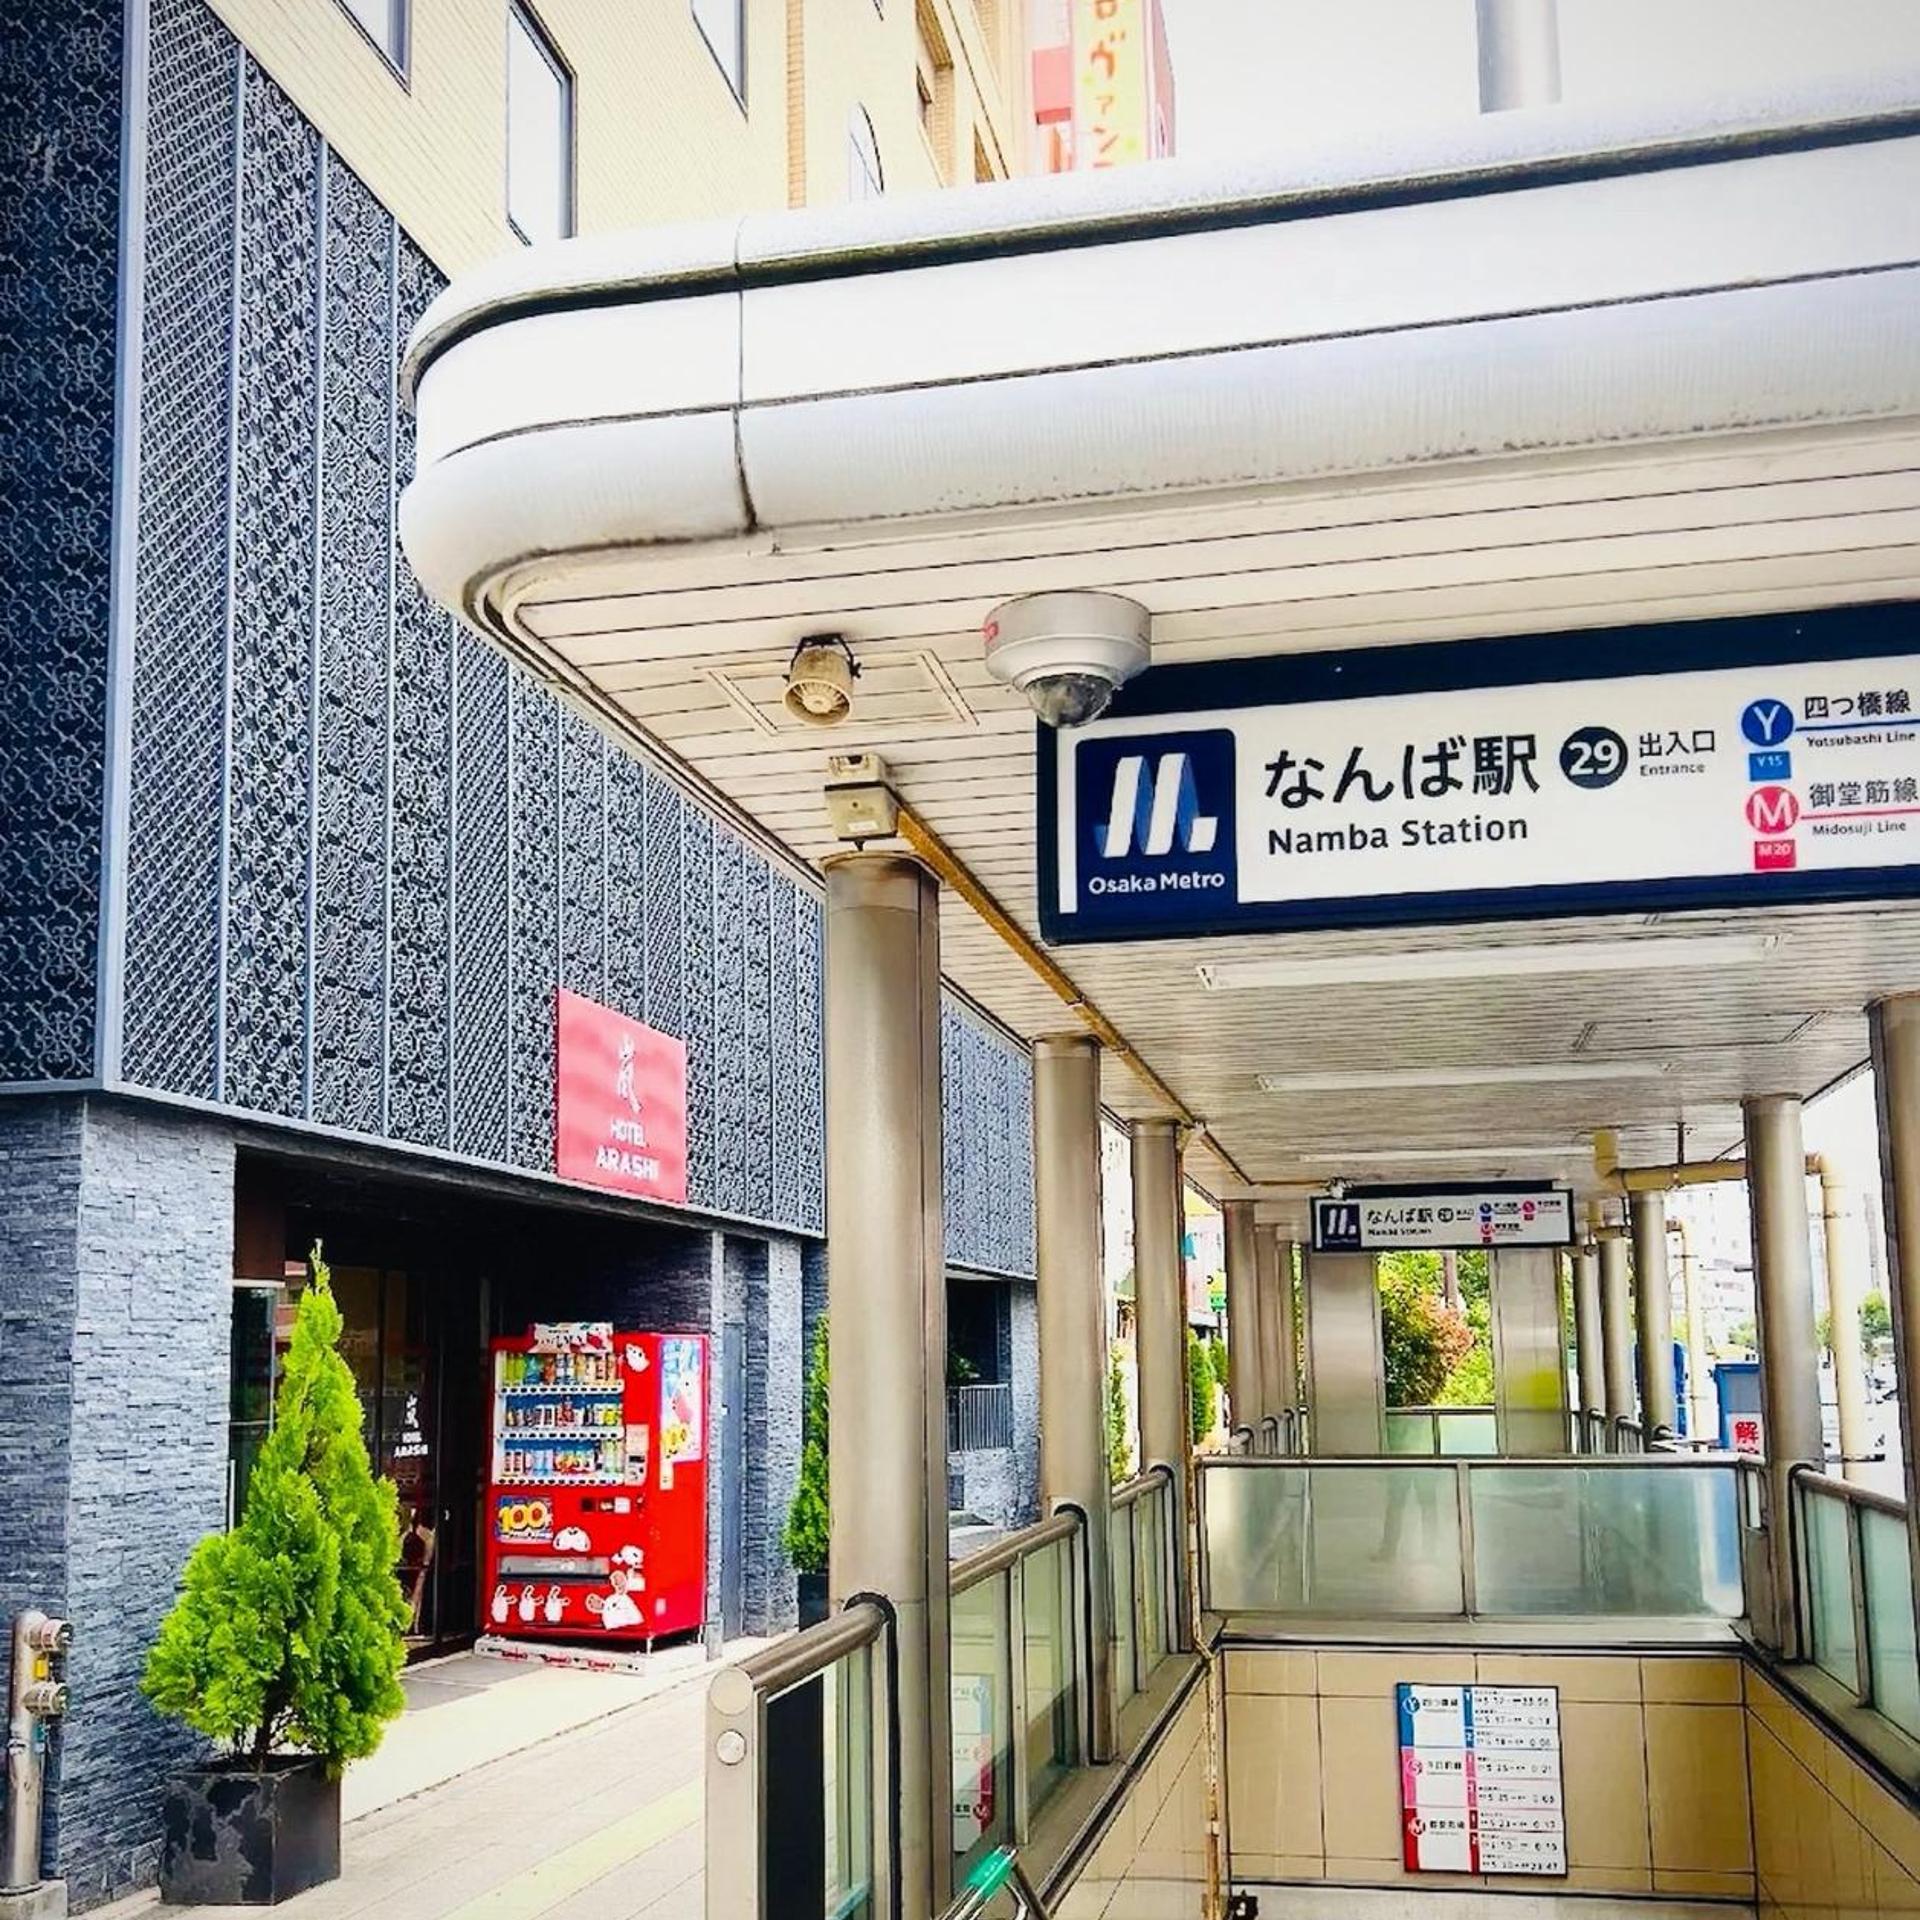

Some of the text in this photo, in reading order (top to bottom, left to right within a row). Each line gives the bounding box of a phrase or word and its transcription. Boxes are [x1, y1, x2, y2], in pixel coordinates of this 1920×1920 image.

[1804, 689, 1912, 720] 四つ橋線
[1752, 704, 1781, 741] Y
[1638, 730, 1717, 758] 出入口
[1806, 730, 1917, 748] Yotsubashi Line
[1265, 734, 1541, 809] なんば駅
[1567, 738, 1621, 776] 29
[1639, 763, 1706, 777] Entrance
[1756, 754, 1784, 768] Y15
[1808, 776, 1919, 808] 御堂筋線
[1753, 791, 1793, 829] M
[1268, 814, 1528, 855] Namba Station
[1812, 820, 1907, 837] Midosuji Line
[1758, 843, 1792, 857] M20
[1088, 871, 1225, 894] Osaka Metro
[596, 1144, 660, 1180] ARASHI
[498, 1500, 548, 1533] 100
